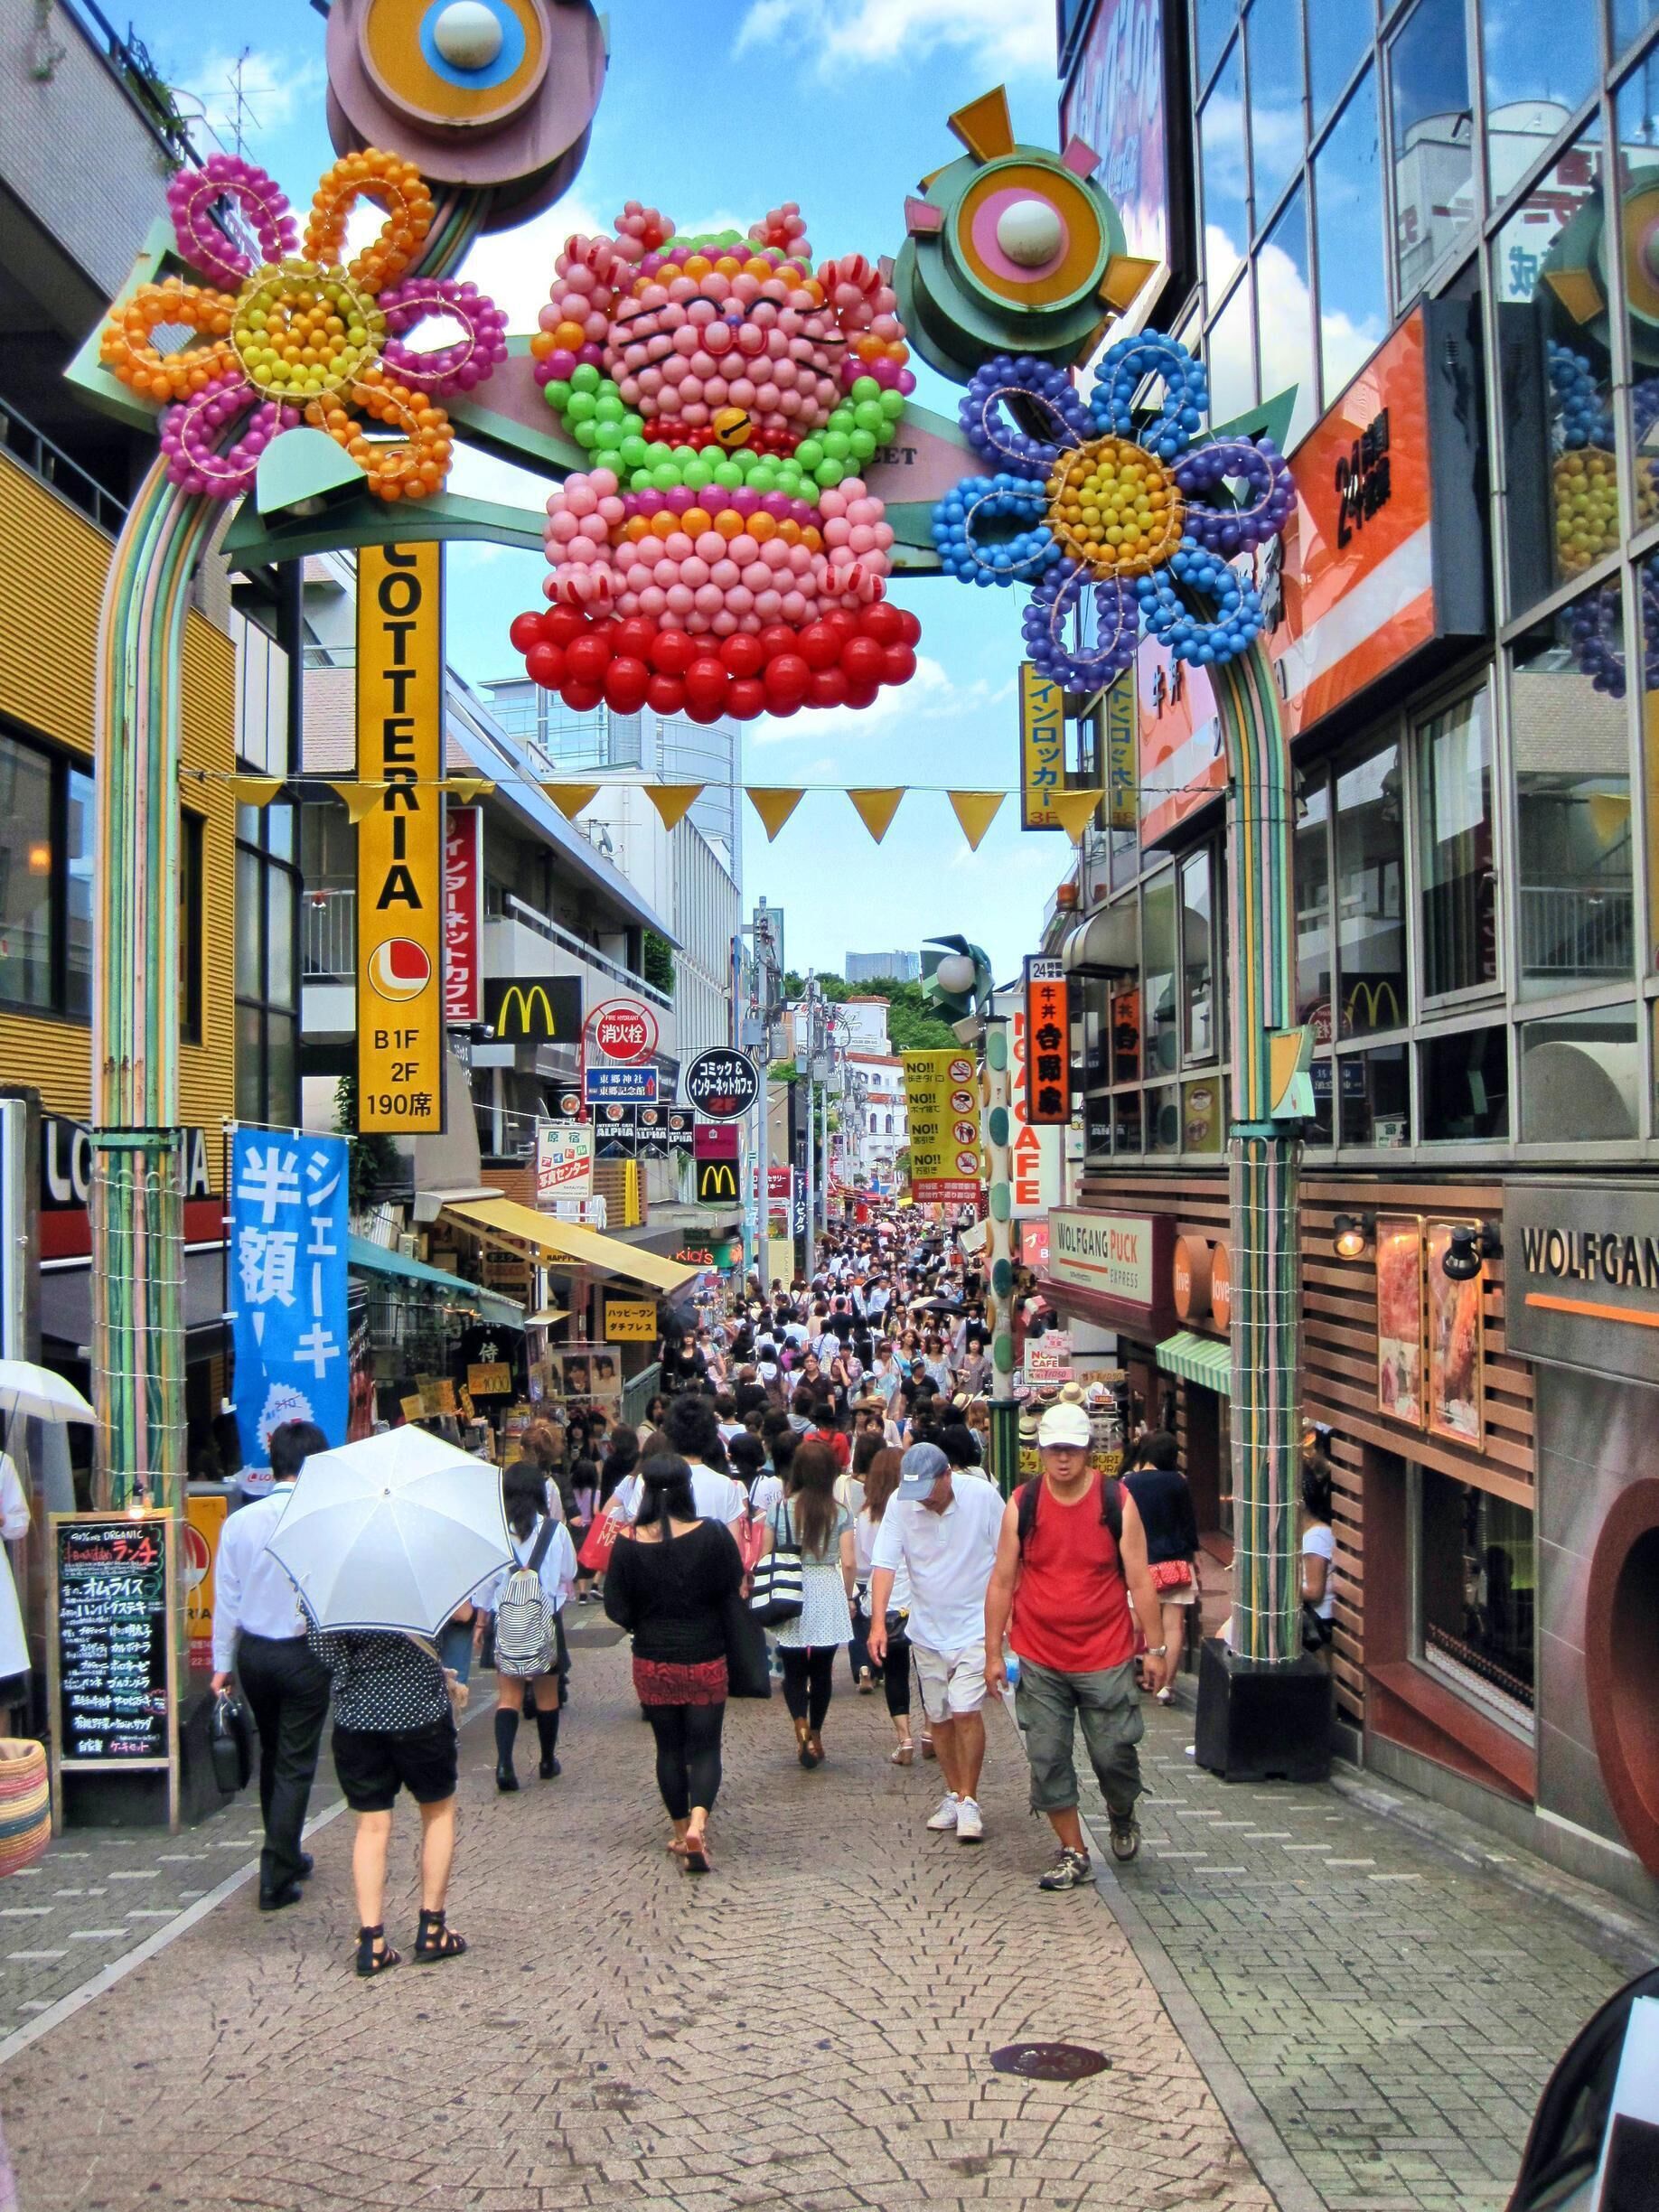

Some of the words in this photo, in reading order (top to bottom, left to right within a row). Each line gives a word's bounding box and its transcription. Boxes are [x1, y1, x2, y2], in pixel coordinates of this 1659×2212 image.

[1040, 986, 1056, 1019] 牛丼
[602, 1024, 643, 1044] 消火栓
[390, 1062, 419, 1082] 2F
[699, 1063, 732, 1076] コミック
[906, 1062, 934, 1073] NO!!
[599, 1073, 643, 1084] 東郷神社
[691, 1076, 753, 1097] インターネットカフェ
[367, 1092, 433, 1117] 190席
[708, 1097, 737, 1112] 2F
[909, 1092, 936, 1104] NO!!
[548, 1131, 580, 1143] 原宿
[596, 1128, 634, 1137] ALPHA
[913, 1123, 939, 1135] NO!!
[914, 1154, 941, 1166] NO!!
[539, 1162, 589, 1187] 写真センター
[1057, 1222, 1109, 1259] WOLFGANG
[1110, 1229, 1139, 1264] PUCK
[294, 1151, 341, 1379] シェーキ
[1110, 1269, 1139, 1289] EXPRESS
[1176, 1264, 1190, 1291] live
[1213, 1272, 1230, 1302] love
[608, 1308, 654, 1317] ハッピーワン
[478, 1341, 499, 1363] 侍
[82, 1577, 144, 1597] オムライス
